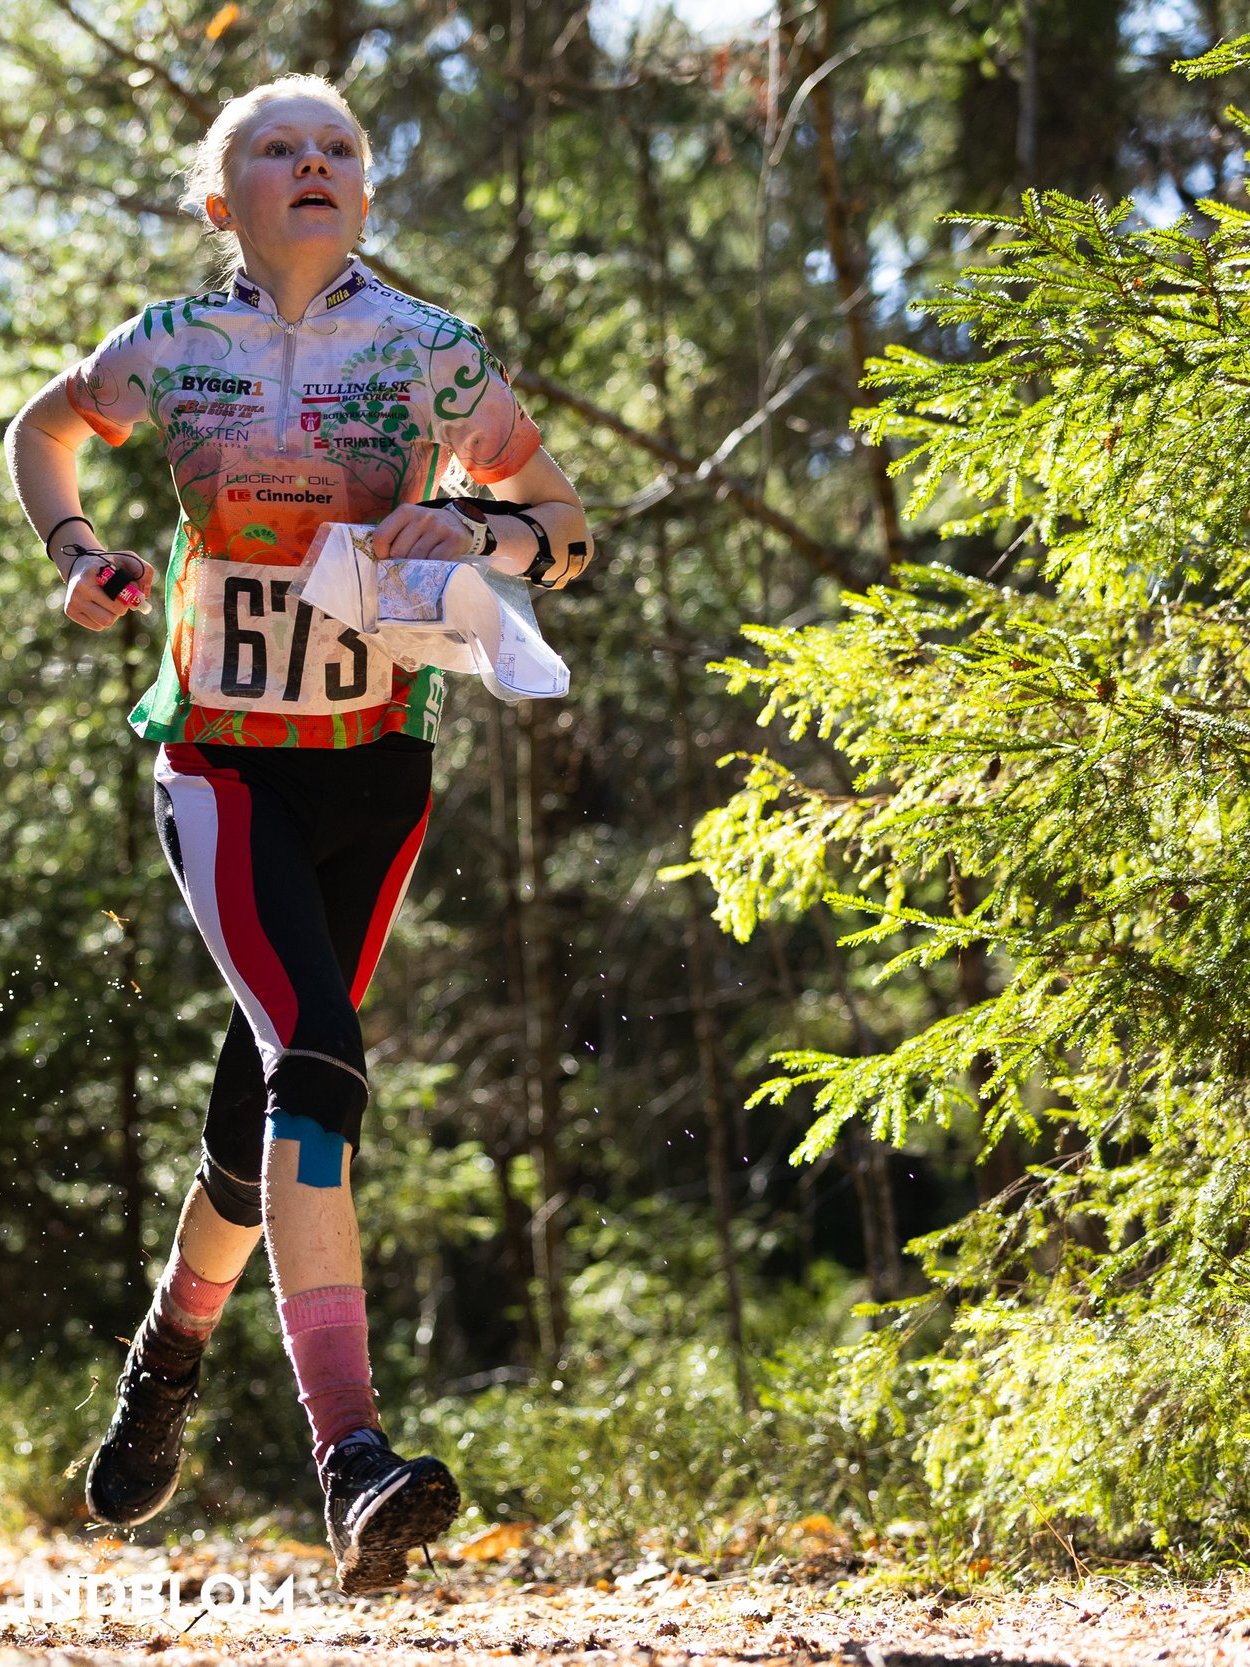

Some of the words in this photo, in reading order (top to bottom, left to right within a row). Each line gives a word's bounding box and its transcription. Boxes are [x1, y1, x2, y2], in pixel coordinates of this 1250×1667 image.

[327, 289, 350, 308] Mila
[181, 375, 264, 397] BYGGR1
[303, 381, 387, 396] TULLINGE
[391, 381, 412, 394] SK
[342, 393, 395, 402] BOTKYRKA
[332, 436, 398, 448] TRIMTEX
[226, 474, 296, 484] LUCENT
[308, 476, 335, 486] OIL
[255, 489, 333, 505] Cinnober
[220, 576, 368, 702] 673
